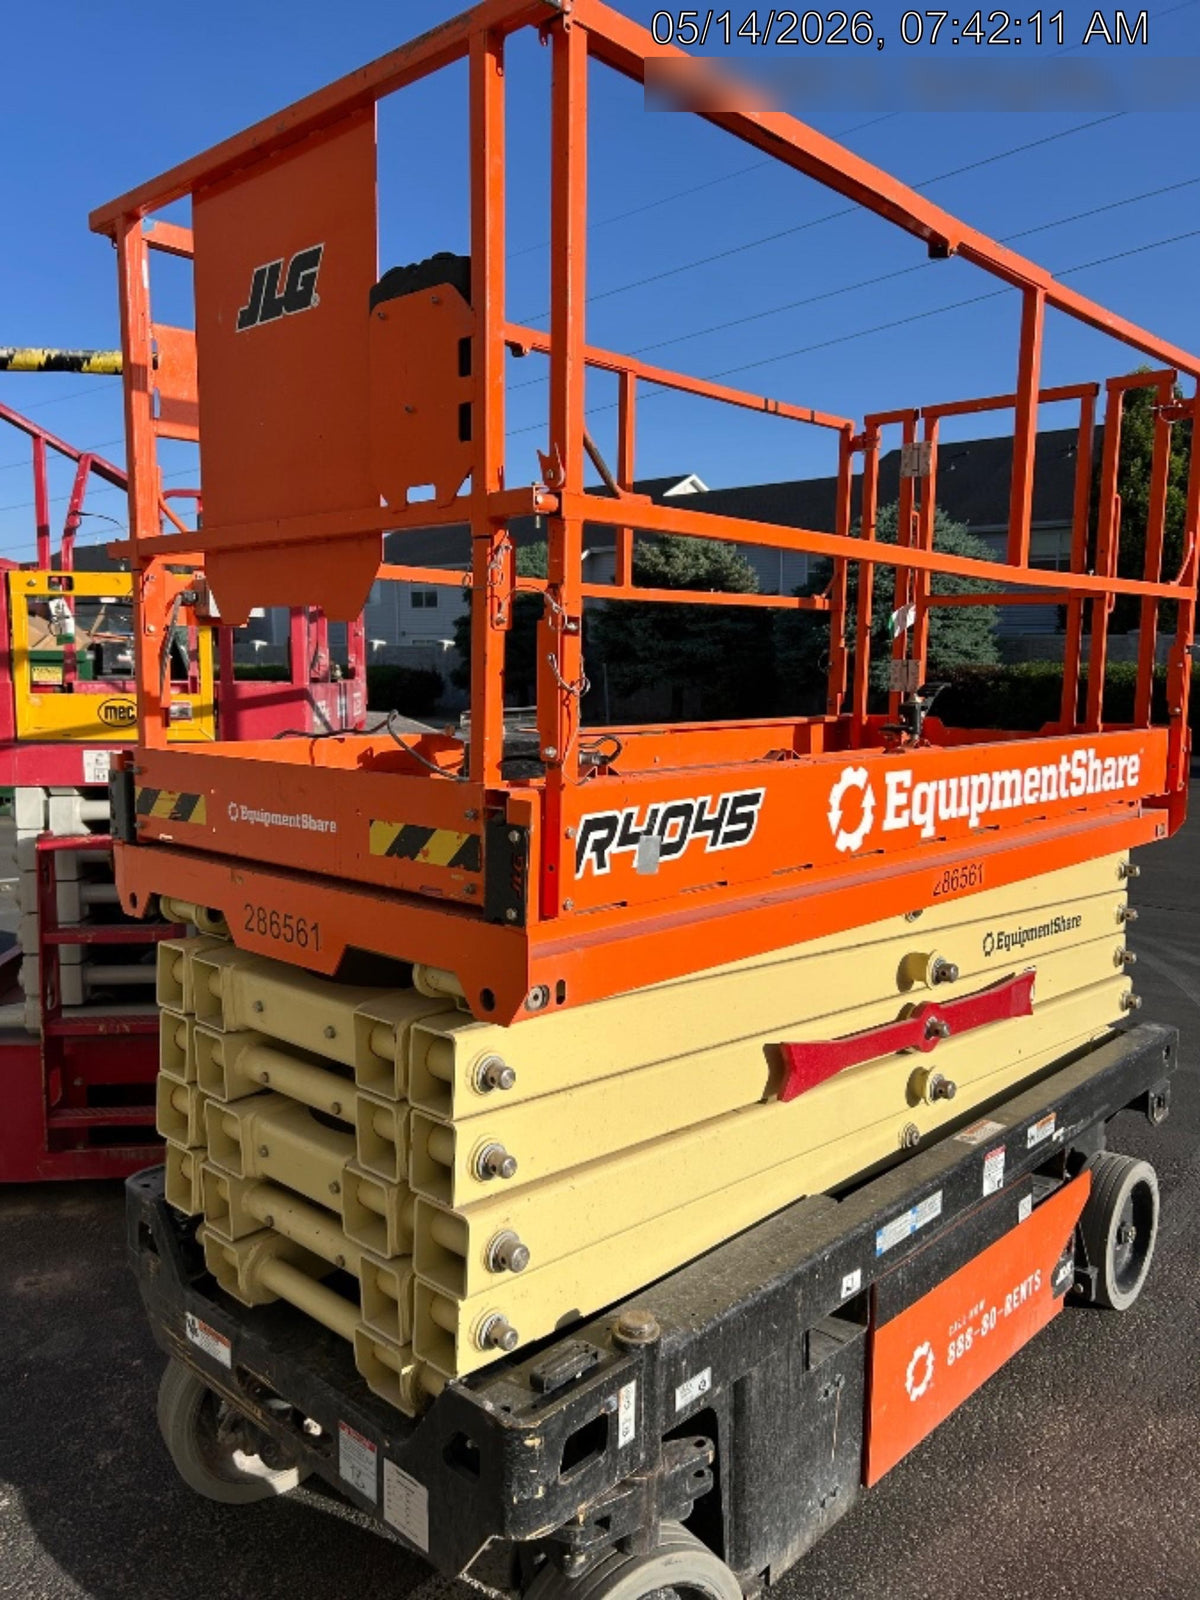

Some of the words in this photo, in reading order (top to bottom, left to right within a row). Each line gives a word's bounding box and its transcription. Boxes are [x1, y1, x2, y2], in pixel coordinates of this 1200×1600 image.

[235, 242, 325, 333] JLG
[104, 704, 136, 721] mec
[883, 748, 1140, 837] EquipmentShare
[240, 804, 337, 833] EquipmentShare
[574, 787, 767, 880] R4045
[933, 861, 985, 897] 286561
[244, 903, 322, 952] 286561
[995, 914, 1082, 952] EquipmentShare
